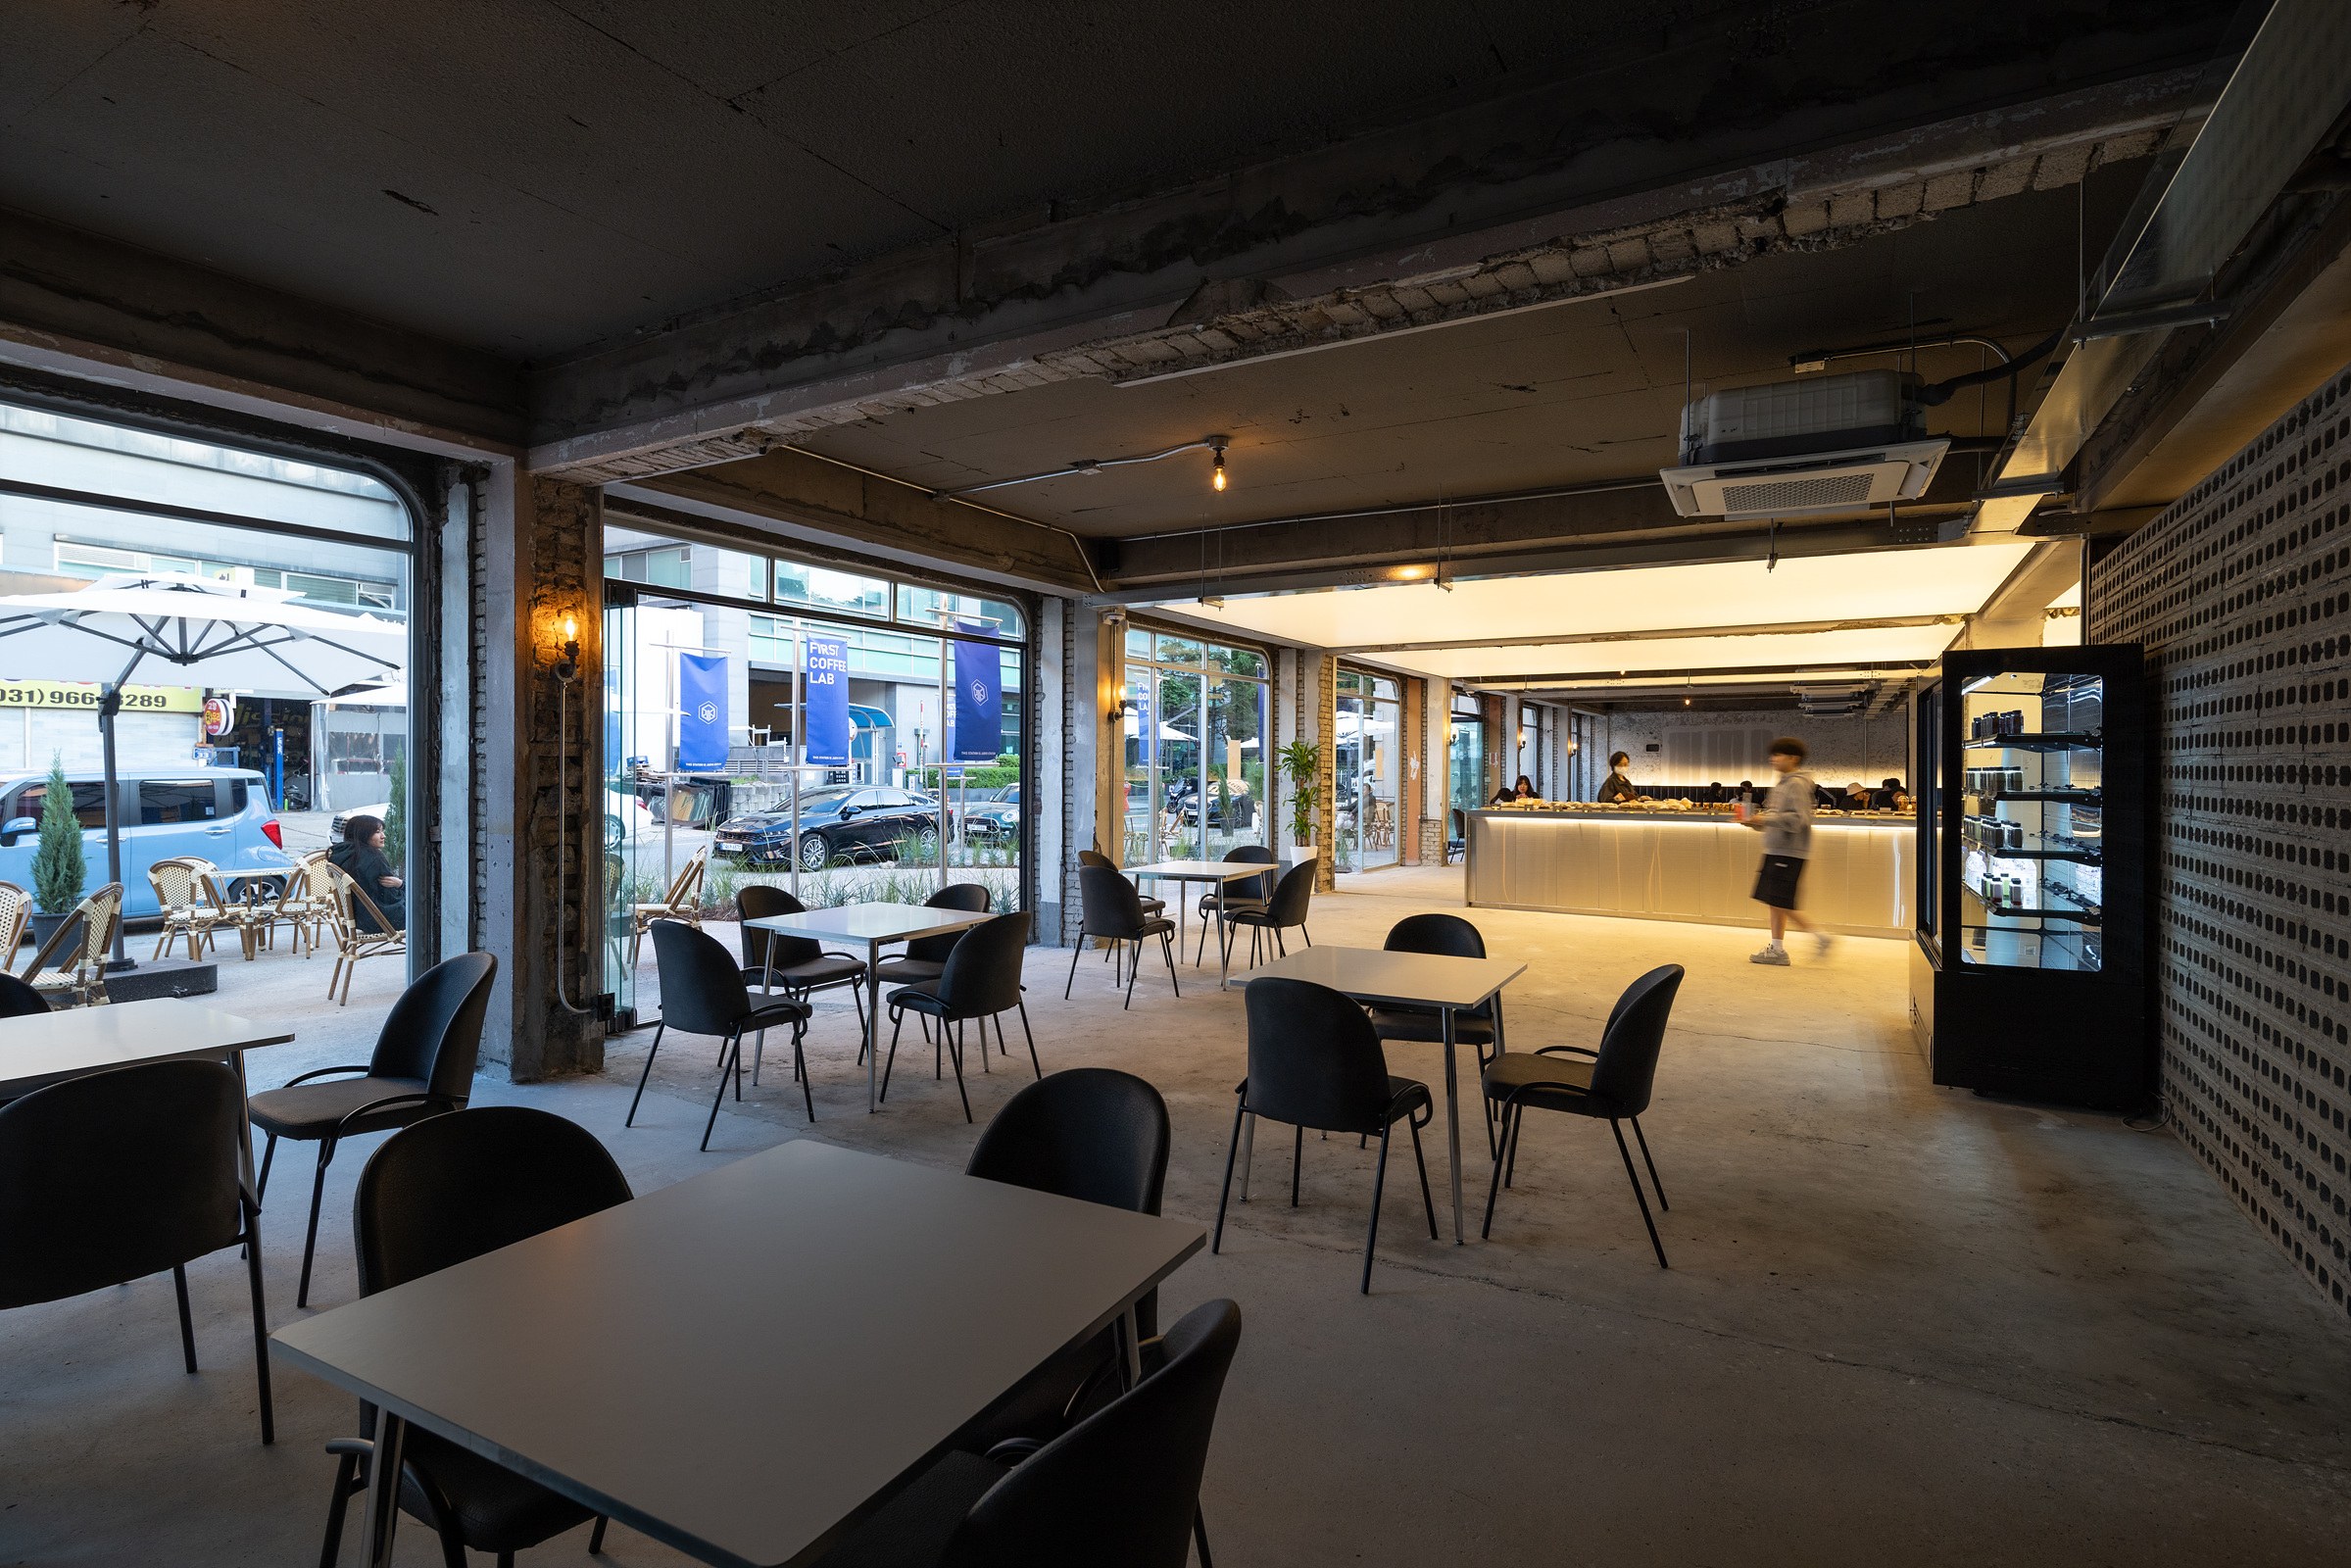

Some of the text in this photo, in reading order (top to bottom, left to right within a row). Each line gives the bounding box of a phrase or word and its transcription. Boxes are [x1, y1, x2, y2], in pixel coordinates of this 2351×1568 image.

[809, 642, 840, 657] FIRST
[809, 656, 847, 672] COFFEE
[809, 671, 835, 685] LAB
[50, 691, 168, 708] 966289
